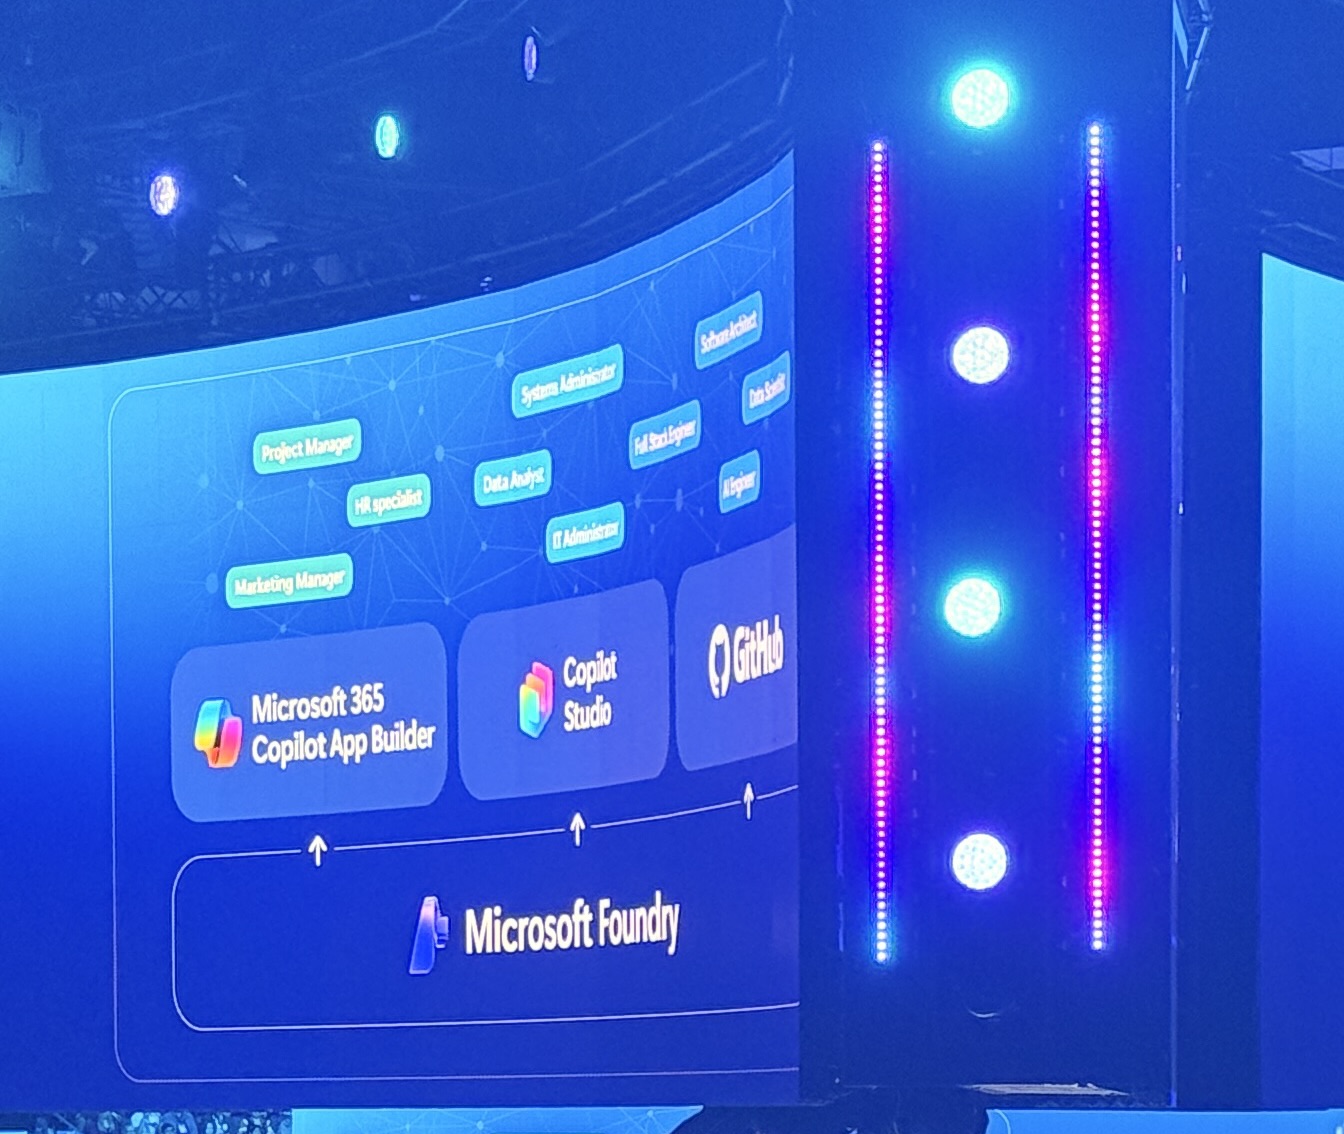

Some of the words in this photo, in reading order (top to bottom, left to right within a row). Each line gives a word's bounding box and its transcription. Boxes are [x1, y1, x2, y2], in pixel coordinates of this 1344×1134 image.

[521, 381, 559, 407] Systems
[261, 441, 304, 465] Project
[305, 435, 354, 456] Manager
[483, 474, 509, 494] Data
[509, 467, 545, 490] Analyst
[354, 495, 372, 514] HR
[372, 488, 423, 516] specialist
[552, 530, 564, 550] IT
[562, 522, 619, 548] Administrator
[234, 575, 294, 596] Marketing
[295, 570, 346, 591] Manager
[733, 614, 784, 684] GitHub
[563, 649, 618, 693] Copilot
[252, 685, 348, 724] Microsoft
[350, 682, 385, 715] 365
[563, 695, 612, 732] Studio
[251, 729, 328, 770] Copilot
[329, 728, 369, 765] App
[371, 718, 437, 754] Builder
[465, 897, 594, 955] Microsoft
[598, 890, 680, 956] Foundry
